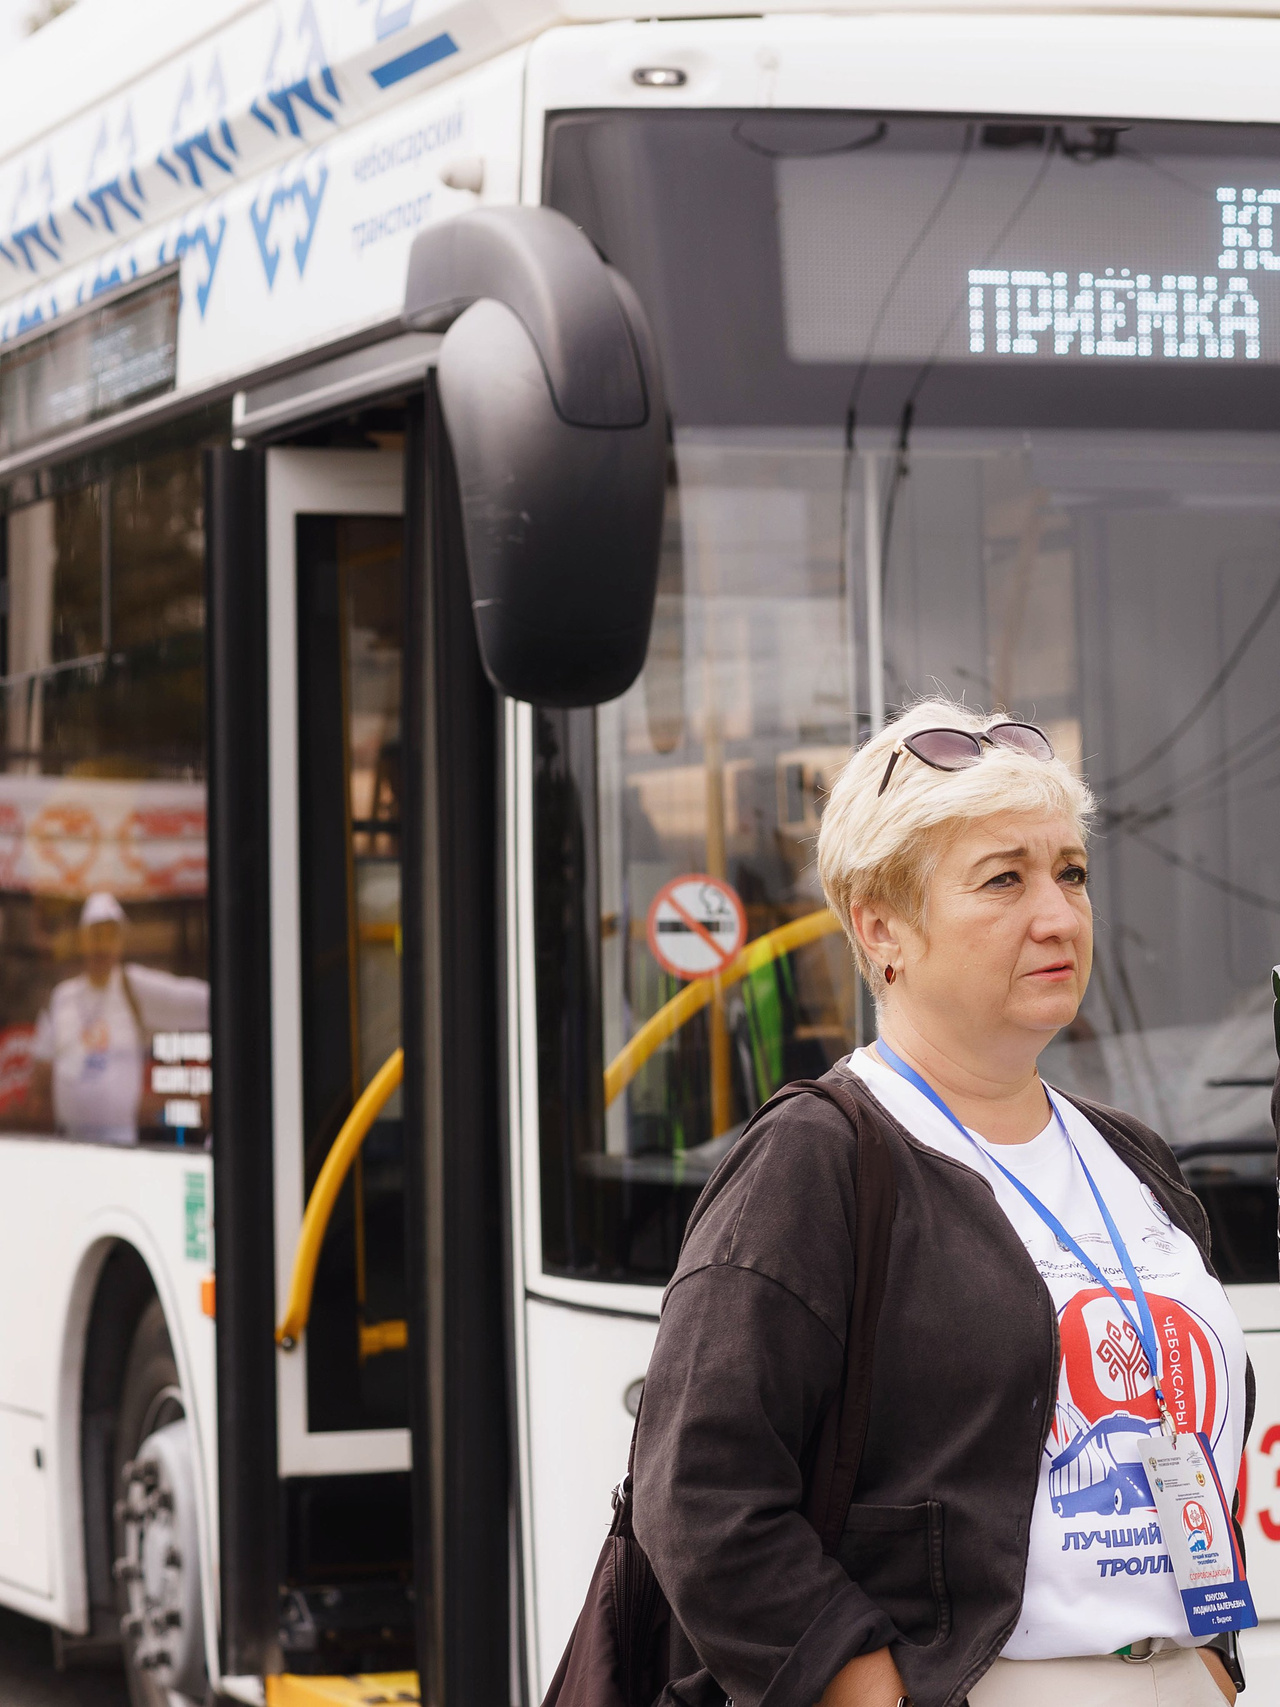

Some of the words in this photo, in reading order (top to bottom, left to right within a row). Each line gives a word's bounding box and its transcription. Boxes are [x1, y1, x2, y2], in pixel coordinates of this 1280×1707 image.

[968, 267, 1260, 359] ПРИЁМКА
[1163, 1316, 1188, 1425] ЧЕБОКСАРЫ
[1062, 1522, 1162, 1551] ЛУЧШИЙ
[1189, 1567, 1231, 1580] СОПРОВОЖДАЮЩИЙ
[1204, 1591, 1228, 1602] ЮНУСОВА
[1193, 1603, 1217, 1615] ЛЮДМИЛА
[1217, 1600, 1246, 1611] ВАЛЕРЬЕВНА
[1217, 1615, 1232, 1624] Видное
